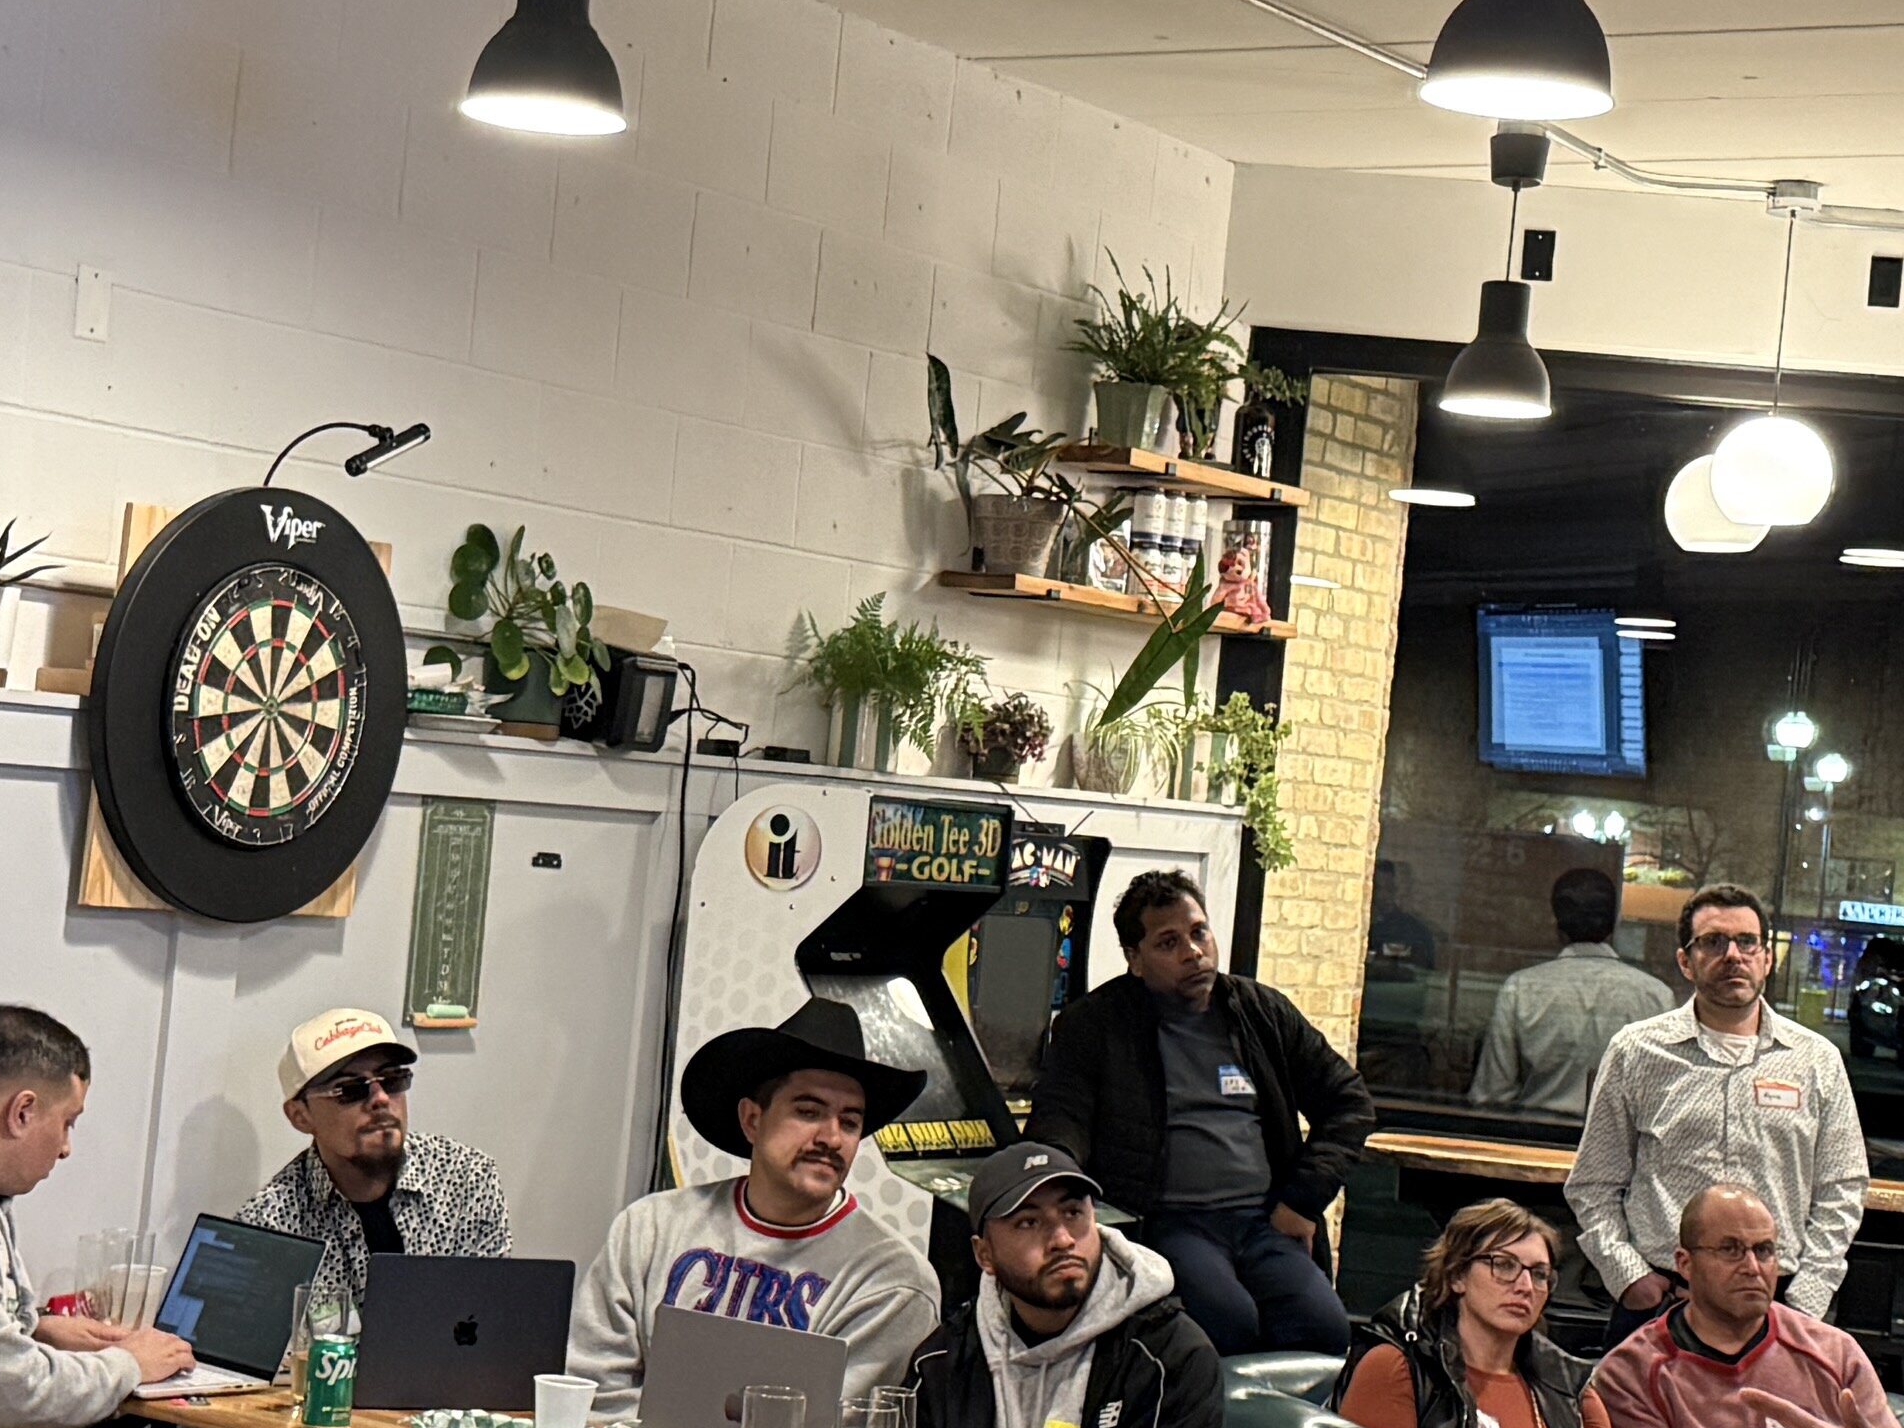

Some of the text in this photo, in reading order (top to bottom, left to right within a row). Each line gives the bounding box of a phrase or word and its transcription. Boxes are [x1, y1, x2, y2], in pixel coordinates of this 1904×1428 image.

[260, 504, 326, 550] Viper
[174, 606, 222, 711] DEAD-ON
[870, 807, 1002, 858] Golden Tee 3D
[1011, 842, 1079, 877] AC-MAN
